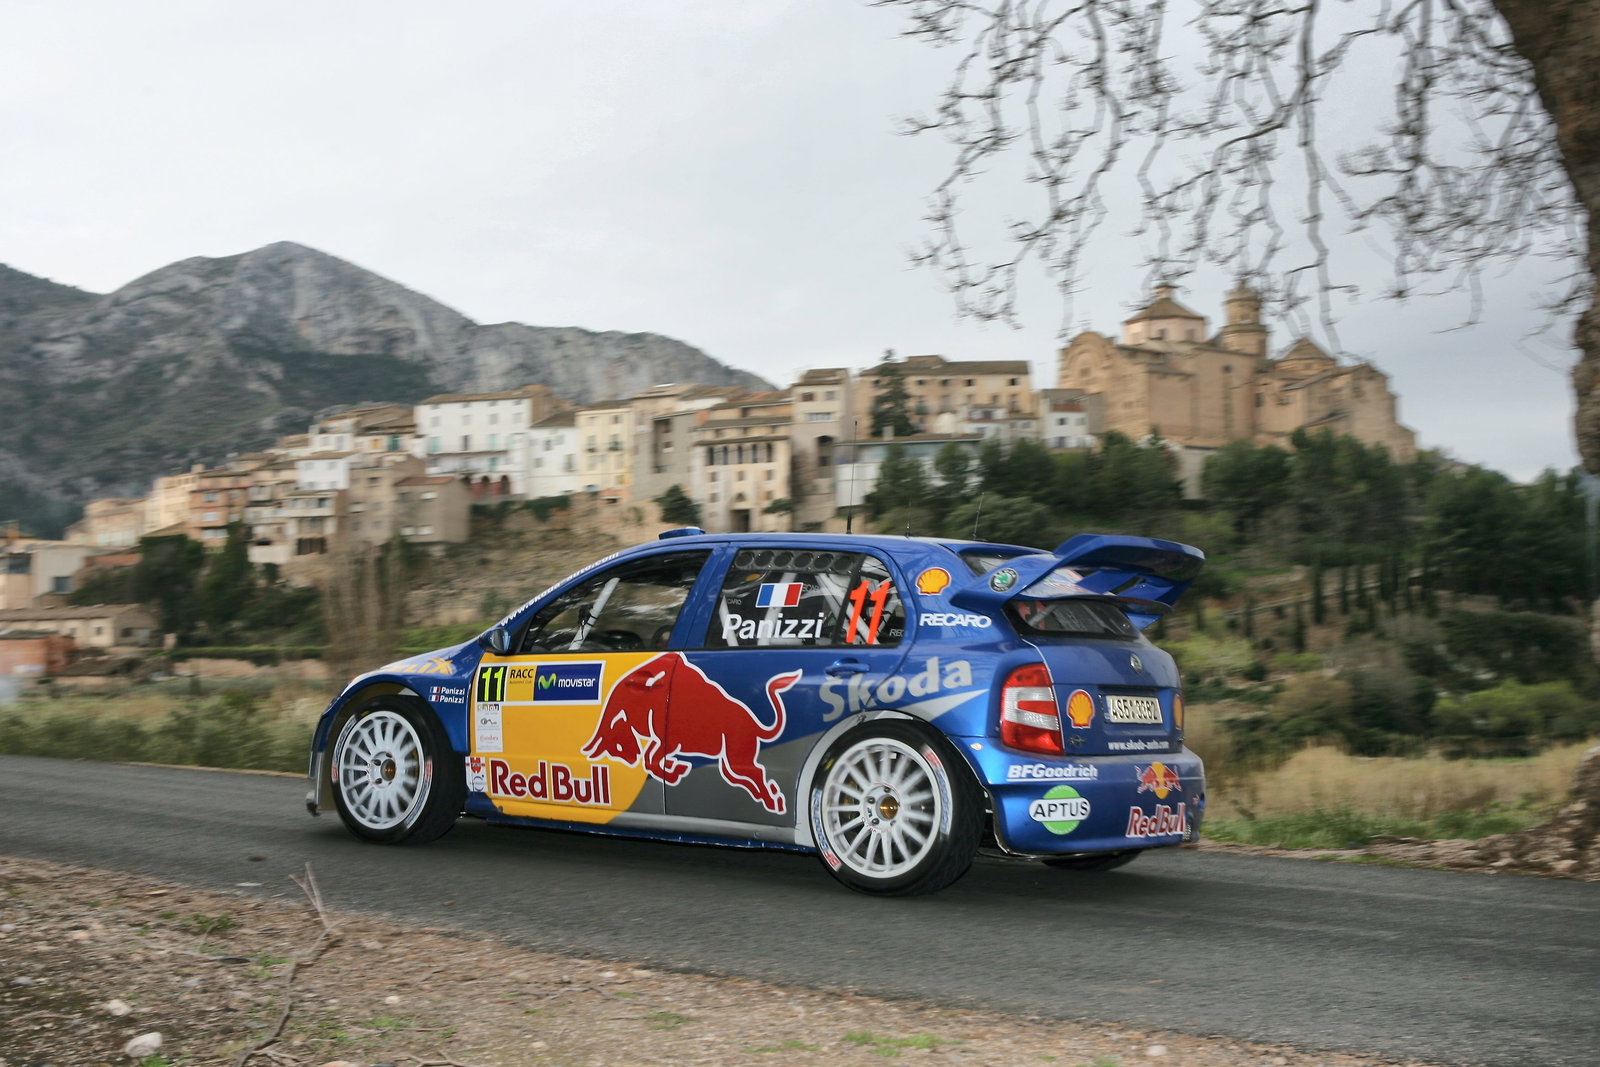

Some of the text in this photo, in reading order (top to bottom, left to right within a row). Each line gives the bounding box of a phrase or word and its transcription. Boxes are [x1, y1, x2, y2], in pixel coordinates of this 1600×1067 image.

[845, 580, 891, 645] 11
[721, 612, 824, 640] Panizzi
[919, 613, 992, 629] RECARO
[509, 668, 534, 679] RACC
[440, 687, 465, 695] Panizzi
[482, 667, 505, 702] 11
[439, 695, 465, 704] Panizzi
[1007, 764, 1098, 778] BFGoodrich
[490, 760, 610, 804] Red Bull
[1033, 801, 1088, 817] APTUS
[1126, 803, 1186, 836] Red Bull
